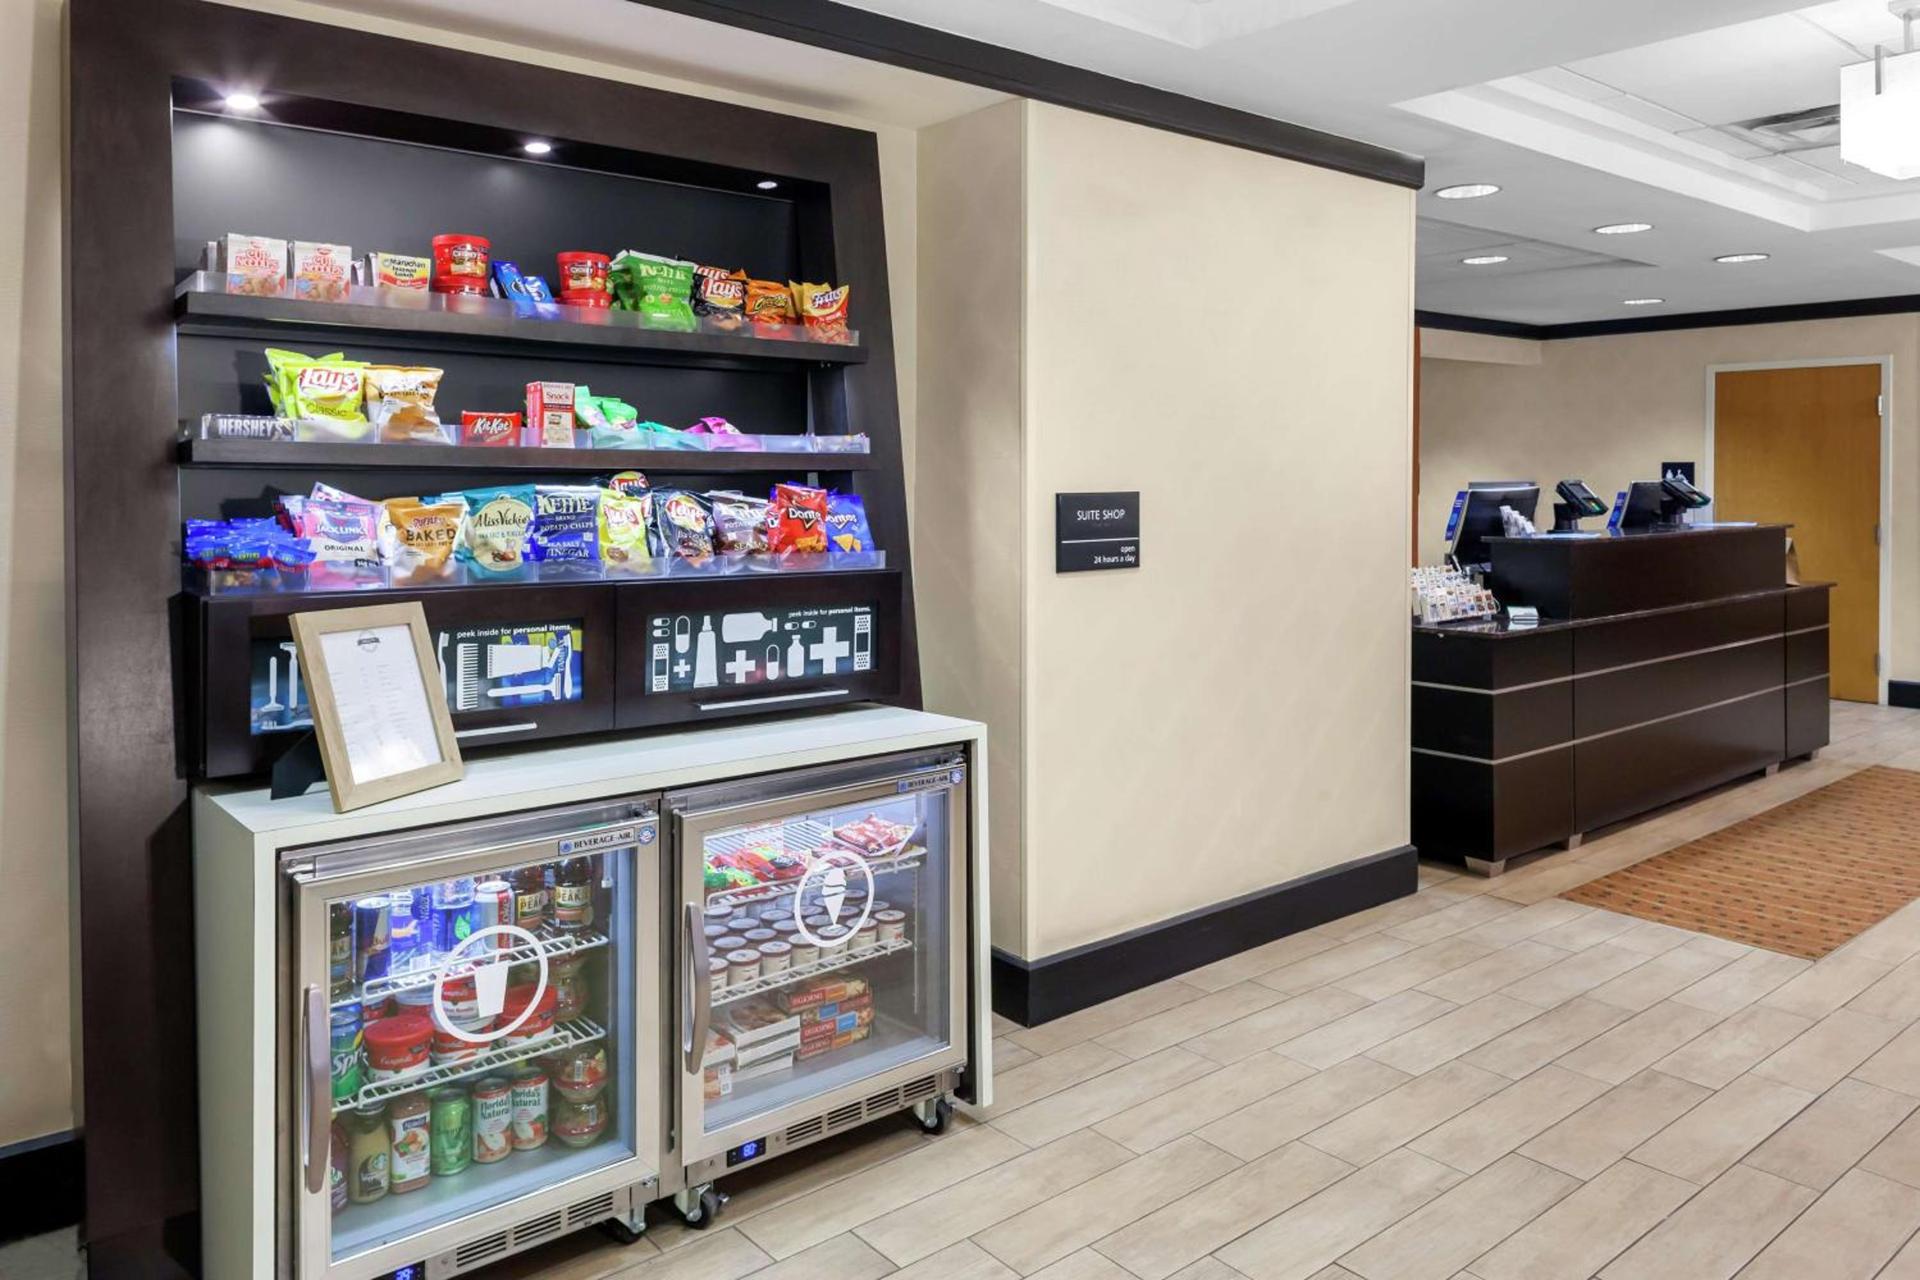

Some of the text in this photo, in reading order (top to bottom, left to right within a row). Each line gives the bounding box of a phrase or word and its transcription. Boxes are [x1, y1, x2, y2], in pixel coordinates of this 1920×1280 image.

[391, 257, 426, 269] Maruchan
[1077, 509, 1125, 520] SUITE SHOP
[406, 527, 456, 542] BAKED
[324, 544, 366, 553] ORIGINAL
[1102, 555, 1120, 564] hours
[1125, 553, 1136, 564] day
[457, 629, 476, 639] peek
[477, 627, 499, 637] inside
[500, 627, 511, 635] for
[513, 624, 547, 635] personal
[481, 1107, 511, 1121] Natura
